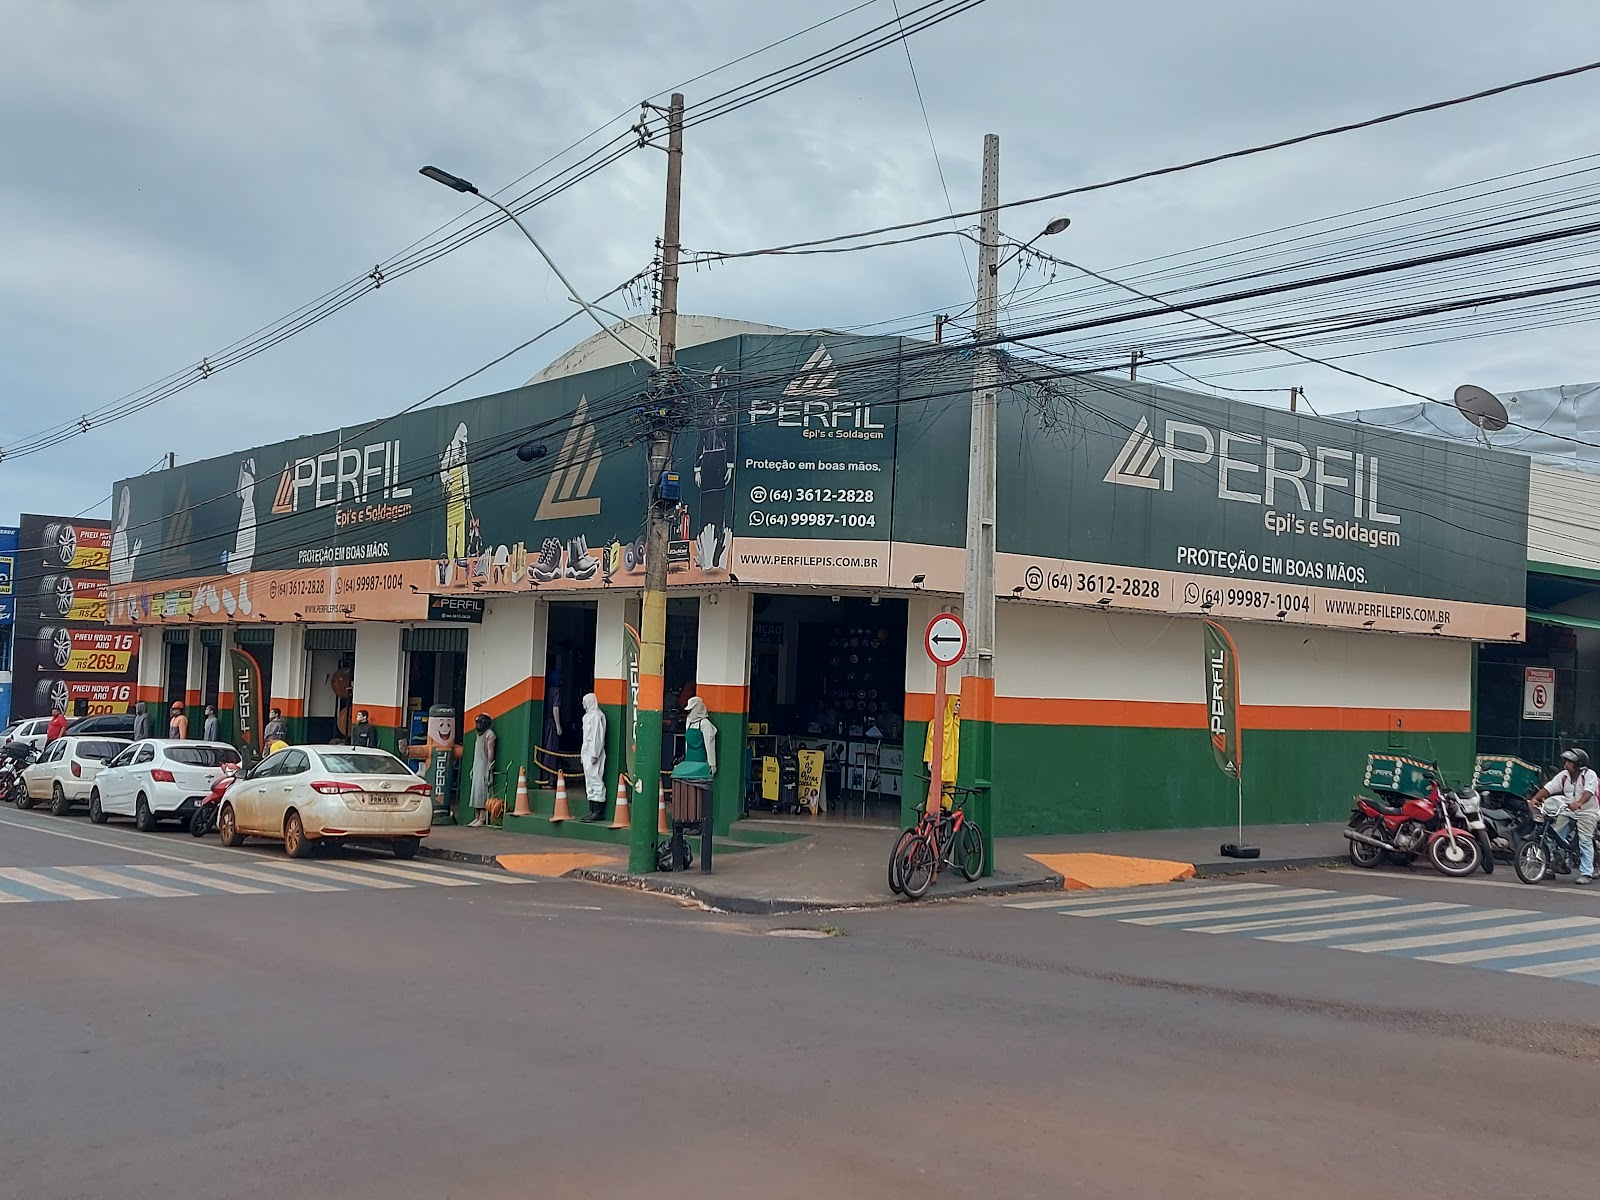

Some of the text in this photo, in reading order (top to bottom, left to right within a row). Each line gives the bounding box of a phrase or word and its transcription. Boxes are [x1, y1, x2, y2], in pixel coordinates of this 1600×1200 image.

[747, 400, 885, 429] PERFIL
[835, 430, 884, 440] Soldagem
[745, 458, 882, 473] Proteção em boas mãos.
[1157, 419, 1401, 524] PERFIL
[291, 439, 413, 513] PERFIL
[769, 488, 874, 503] (64) 3612-2828
[365, 503, 412, 522] Soldagem
[765, 513, 876, 528] (64) 99987-1004
[79, 530, 99, 539] PNEU
[1322, 518, 1401, 548] Soldagem
[298, 541, 390, 566] PROTEÇÃO EM BOAS MÃOS.
[740, 554, 879, 568] WWW.PERFILEPIS.COM.BR
[1176, 545, 1368, 585] PROTEÇÃO EM BOAS MÃOS.
[288, 579, 325, 595] 3612-2828
[343, 574, 403, 593] (64) 99987-1004
[1047, 572, 1160, 599] (64) 3612-2828
[440, 598, 482, 611] PERFIL
[1201, 588, 1310, 613] (64) 99987-1004
[1325, 598, 1451, 624] WWW.PERFILEPIS.COM.BR
[74, 633, 113, 642] PNEU NOVO
[94, 641, 110, 649] ARO
[113, 634, 134, 650] 15
[72, 684, 110, 693] PNEU NOVO
[93, 692, 107, 700] ARO
[111, 685, 131, 700] 16
[1211, 649, 1226, 736] PERFIL
[238, 668, 251, 733] PERFIL
[435, 751, 447, 795] PERFIL
